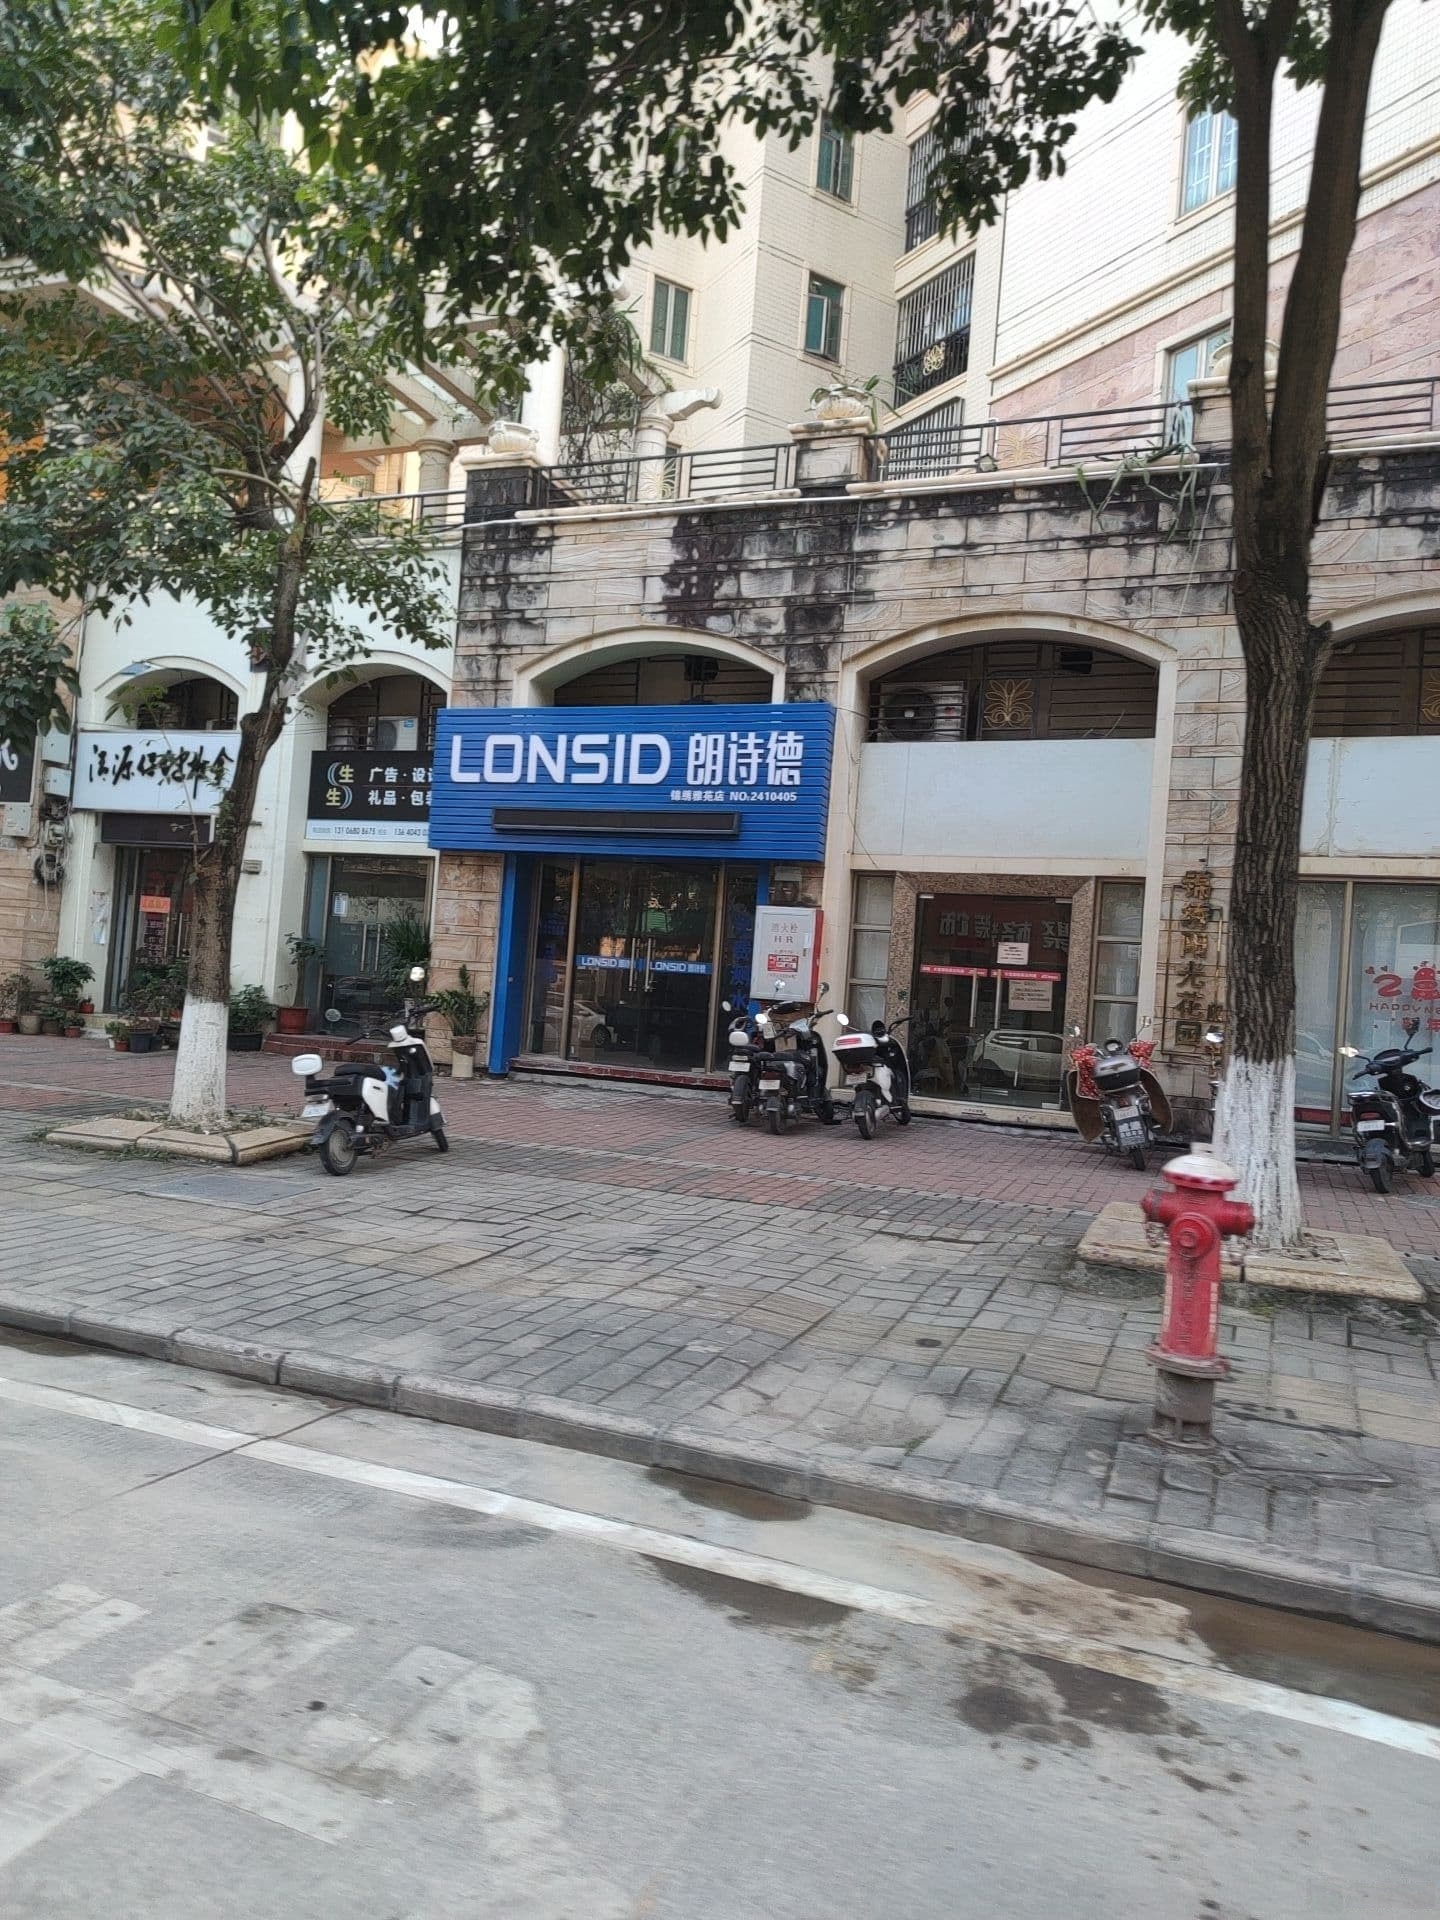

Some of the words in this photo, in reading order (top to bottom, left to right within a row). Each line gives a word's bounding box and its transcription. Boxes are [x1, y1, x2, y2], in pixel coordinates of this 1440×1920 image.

[450, 734, 671, 784] LONSID
[686, 731, 803, 786] 朗诗德
[338, 764, 355, 783] 生
[325, 787, 342, 806] 生
[581, 957, 618, 968] LONSID
[650, 961, 687, 972] LONSID
